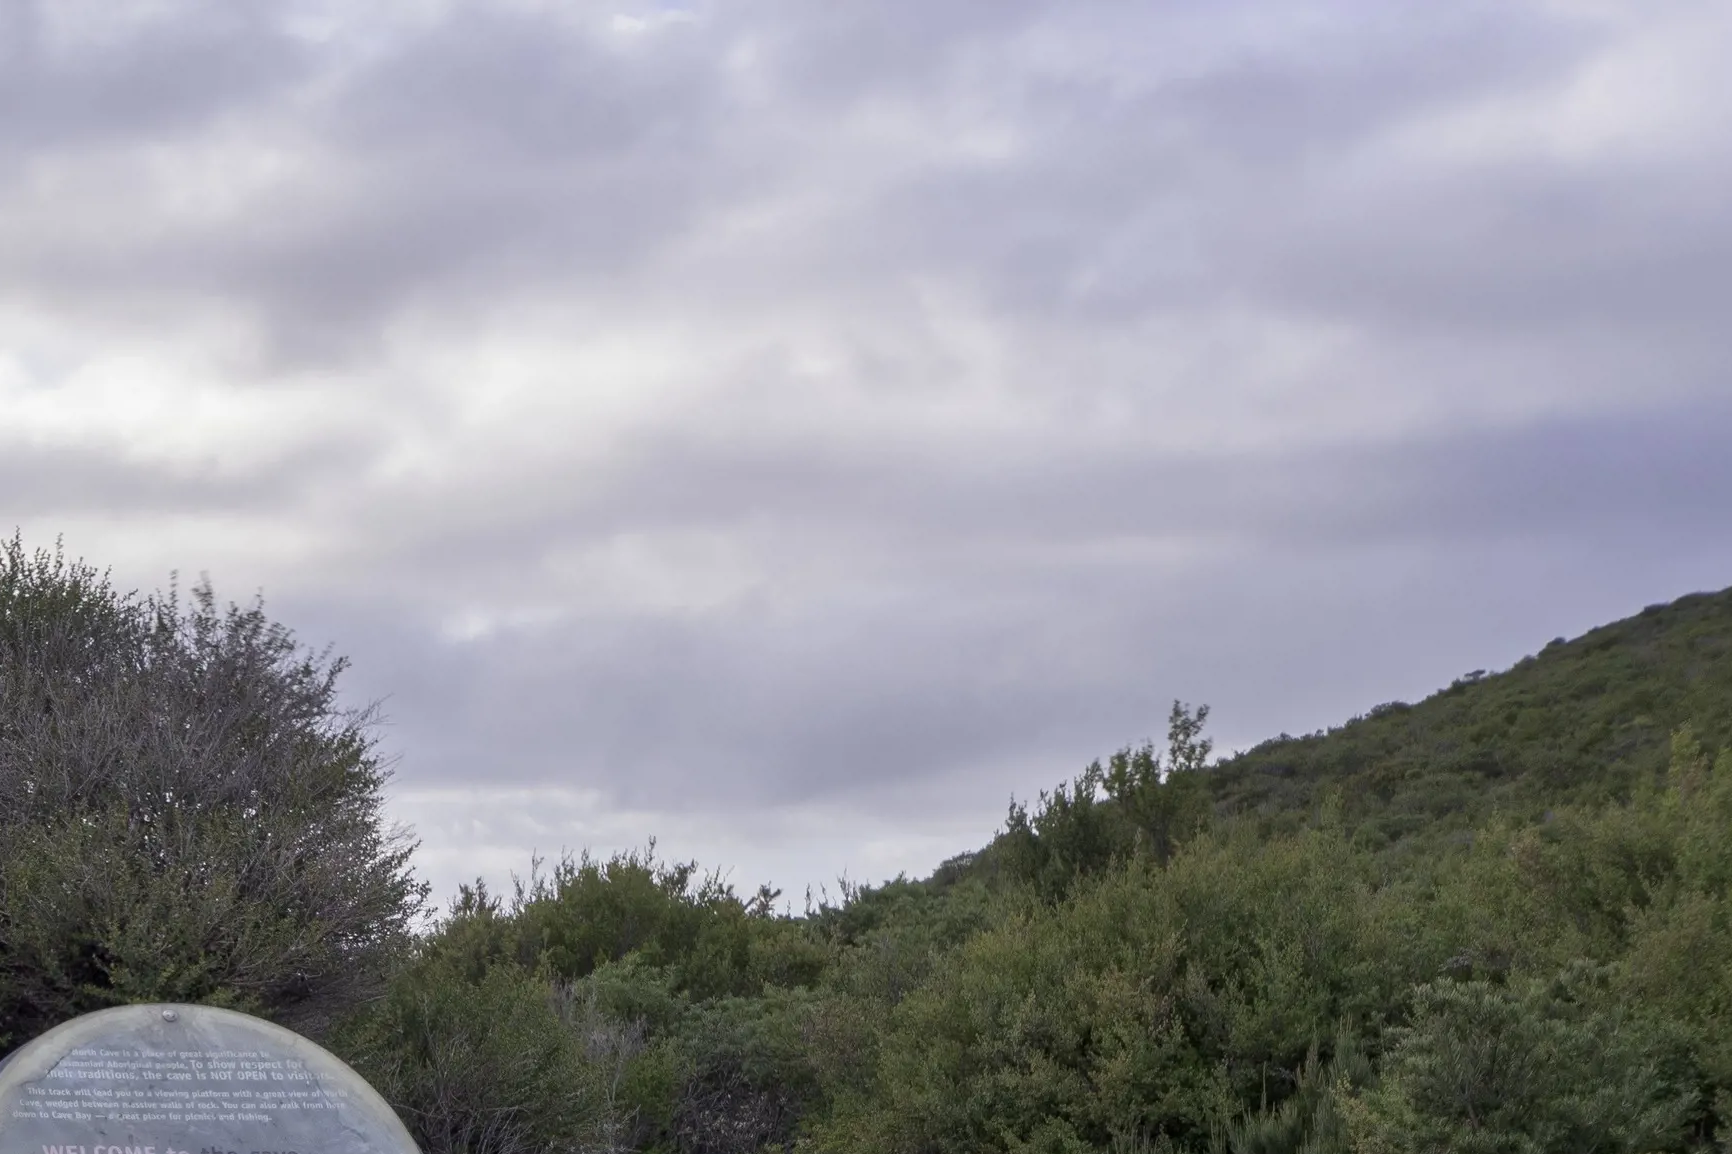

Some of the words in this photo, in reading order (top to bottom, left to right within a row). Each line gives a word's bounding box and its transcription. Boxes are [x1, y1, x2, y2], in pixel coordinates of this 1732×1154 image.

[100, 1048, 119, 1058] Cave
[122, 1049, 130, 1058] is
[133, 1050, 139, 1058] a
[142, 1049, 163, 1060] place
[168, 1050, 177, 1058] of
[179, 1050, 202, 1061] great
[206, 1050, 257, 1060] significance
[259, 1050, 270, 1058] to
[107, 1060, 152, 1070] Aboriginal
[190, 1059, 203, 1069] To
[208, 1059, 236, 1069] show
[240, 1059, 282, 1071] respect
[286, 1059, 303, 1069] for
[78, 1069, 139, 1081] traditions,
[143, 1070, 162, 1080] the
[167, 1072, 192, 1081] cave
[196, 1071, 206, 1081] is
[210, 1070, 232, 1081] NOT
[237, 1070, 267, 1081] OPEN
[271, 1071, 284, 1081] to
[27, 1087, 46, 1096] This
[48, 1088, 70, 1097] track
[74, 1088, 91, 1097] will
[94, 1088, 113, 1098] lead
[116, 1090, 131, 1100] you
[134, 1089, 144, 1098] to
[155, 1089, 189, 1100] viewing
[192, 1089, 230, 1100] platform
[233, 1089, 253, 1098] with
[262, 1090, 286, 1101] great
[288, 1090, 308, 1098] view
[311, 1090, 320, 1098] of
[19, 1099, 43, 1109] Cave,
[46, 1100, 79, 1110] wedged
[81, 1100, 119, 1109] between
[122, 1101, 157, 1109] massive
[160, 1100, 183, 1109] walls
[185, 1101, 194, 1109] of
[197, 1100, 220, 1109] rock.
[222, 1101, 238, 1109] You
[259, 1101, 277, 1109] also
[280, 1100, 300, 1109] walk
[303, 1100, 323, 1109] from
[12, 1110, 37, 1119] down
[39, 1111, 49, 1119] to
[51, 1110, 73, 1120] Cave
[75, 1111, 92, 1121] Bay
[142, 1112, 166, 1122] place
[169, 1111, 182, 1120] for
[219, 1113, 234, 1121] and
[238, 1112, 272, 1123] fishing.
